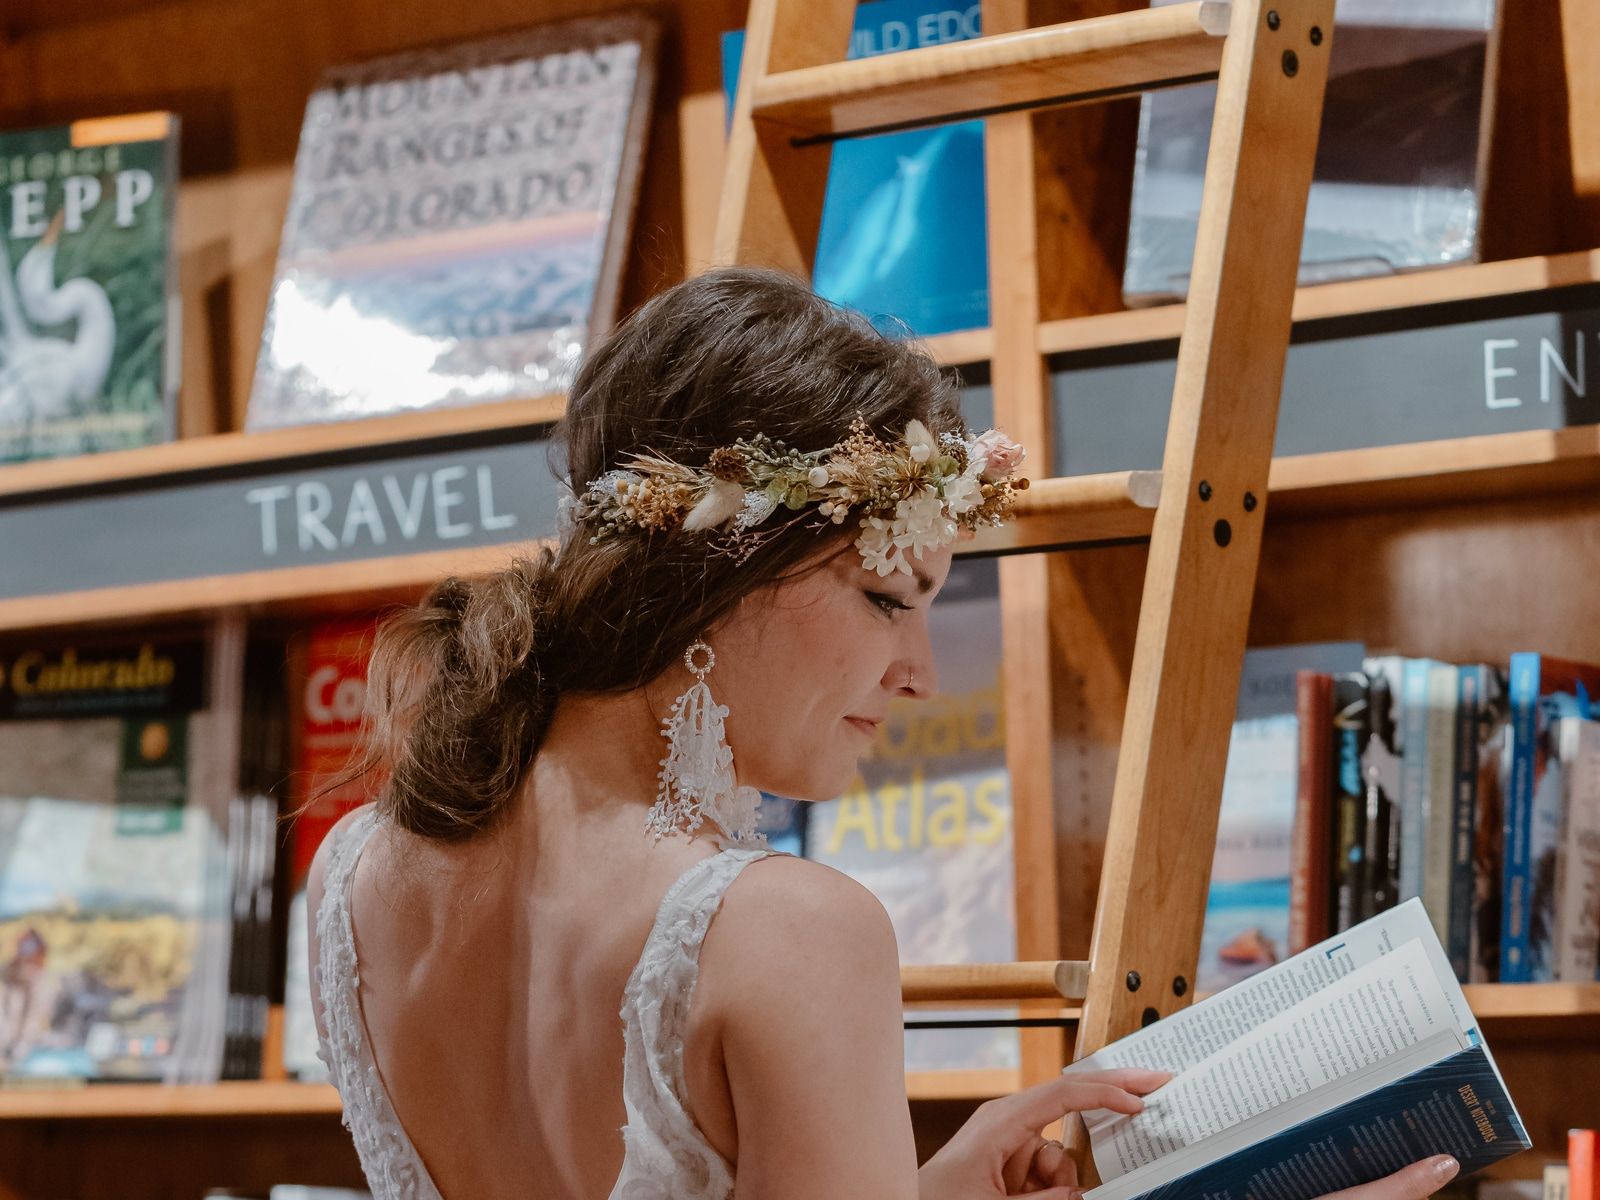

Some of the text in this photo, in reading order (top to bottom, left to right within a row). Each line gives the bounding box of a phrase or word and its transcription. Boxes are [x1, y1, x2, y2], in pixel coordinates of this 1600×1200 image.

[1483, 329, 1600, 409] EN
[245, 463, 519, 556] TRAVEL
[870, 664, 1007, 758] oad
[828, 764, 1006, 854] Atlas
[1458, 1084, 1481, 1109] DESERT
[1470, 1107, 1498, 1143] NOTEBOOKS
